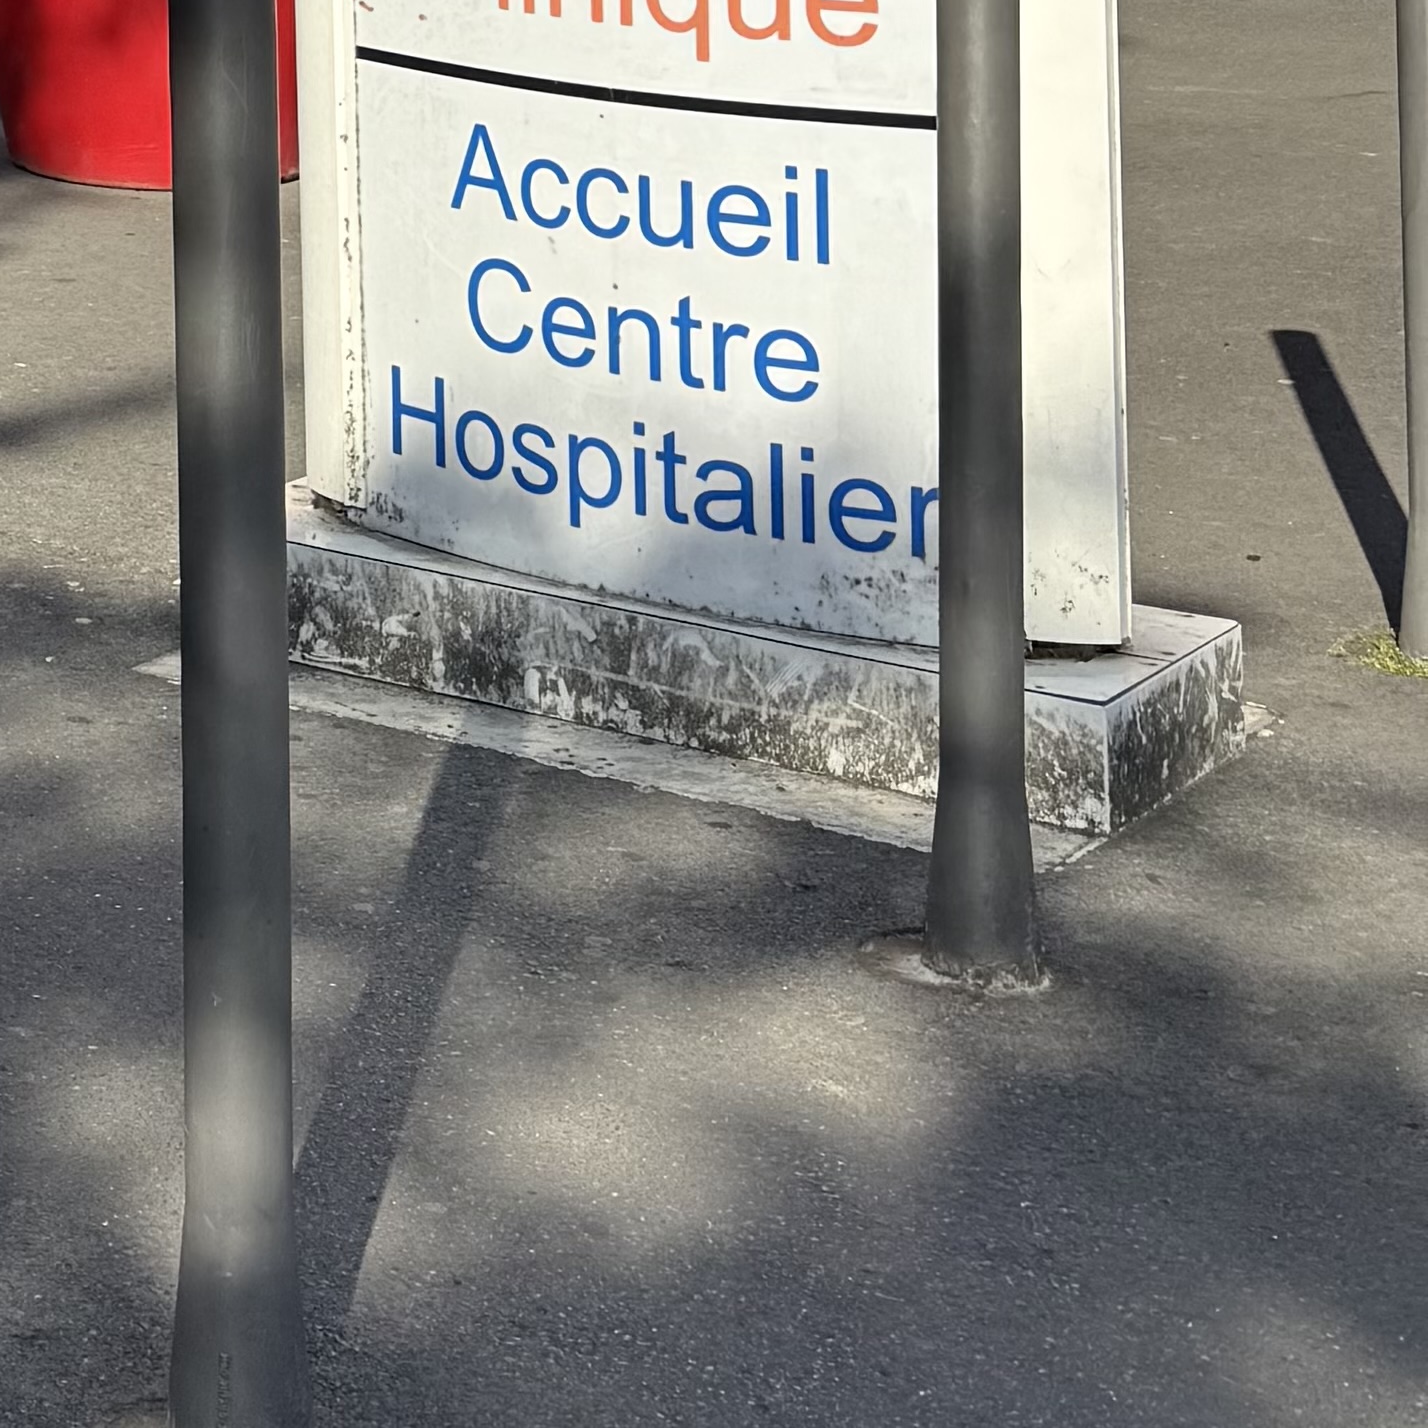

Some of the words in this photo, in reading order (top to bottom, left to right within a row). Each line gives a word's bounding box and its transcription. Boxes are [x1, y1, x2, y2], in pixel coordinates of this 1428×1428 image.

[451, 124, 830, 265] Accueil
[468, 258, 820, 402] Centre
[391, 365, 939, 560] Hospitalier
